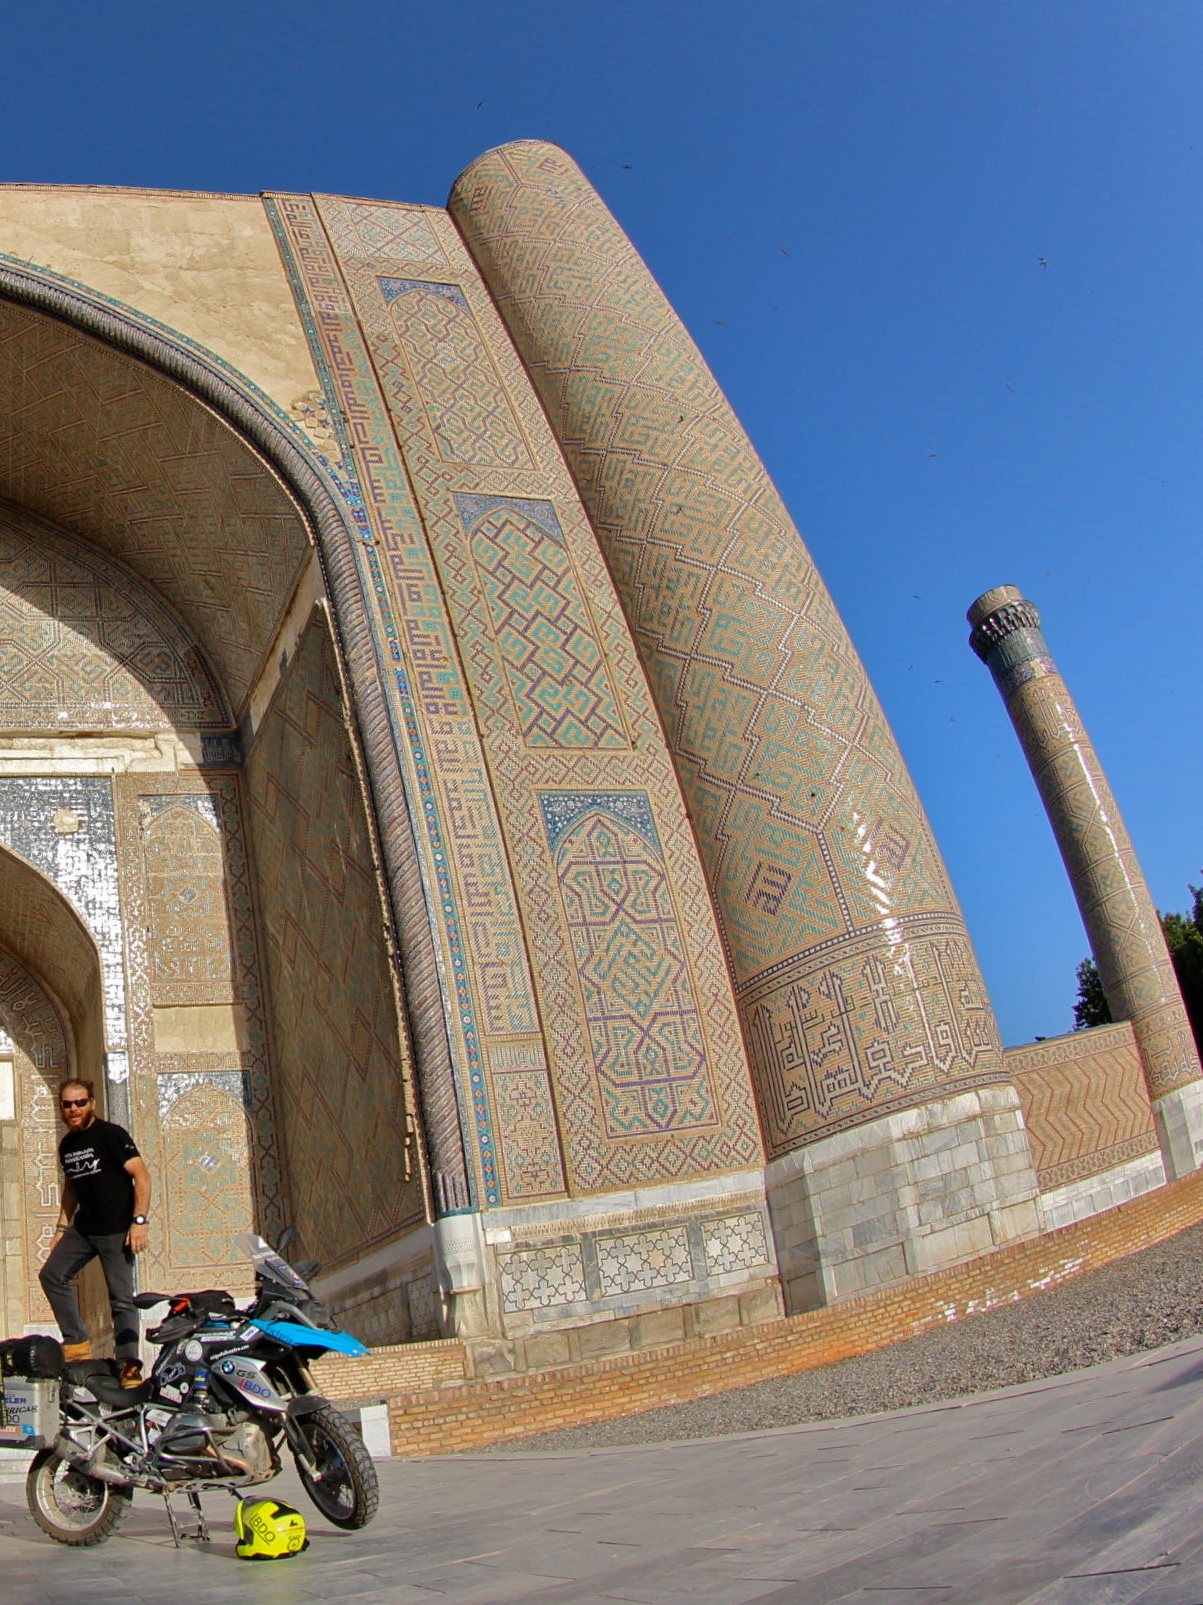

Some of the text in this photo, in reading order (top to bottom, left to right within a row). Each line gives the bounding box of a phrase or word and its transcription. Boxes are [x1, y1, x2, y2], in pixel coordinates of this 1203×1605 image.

[236, 1369, 257, 1380] GS
[243, 1380, 271, 1399] BDO
[252, 1516, 275, 1542] BDO
